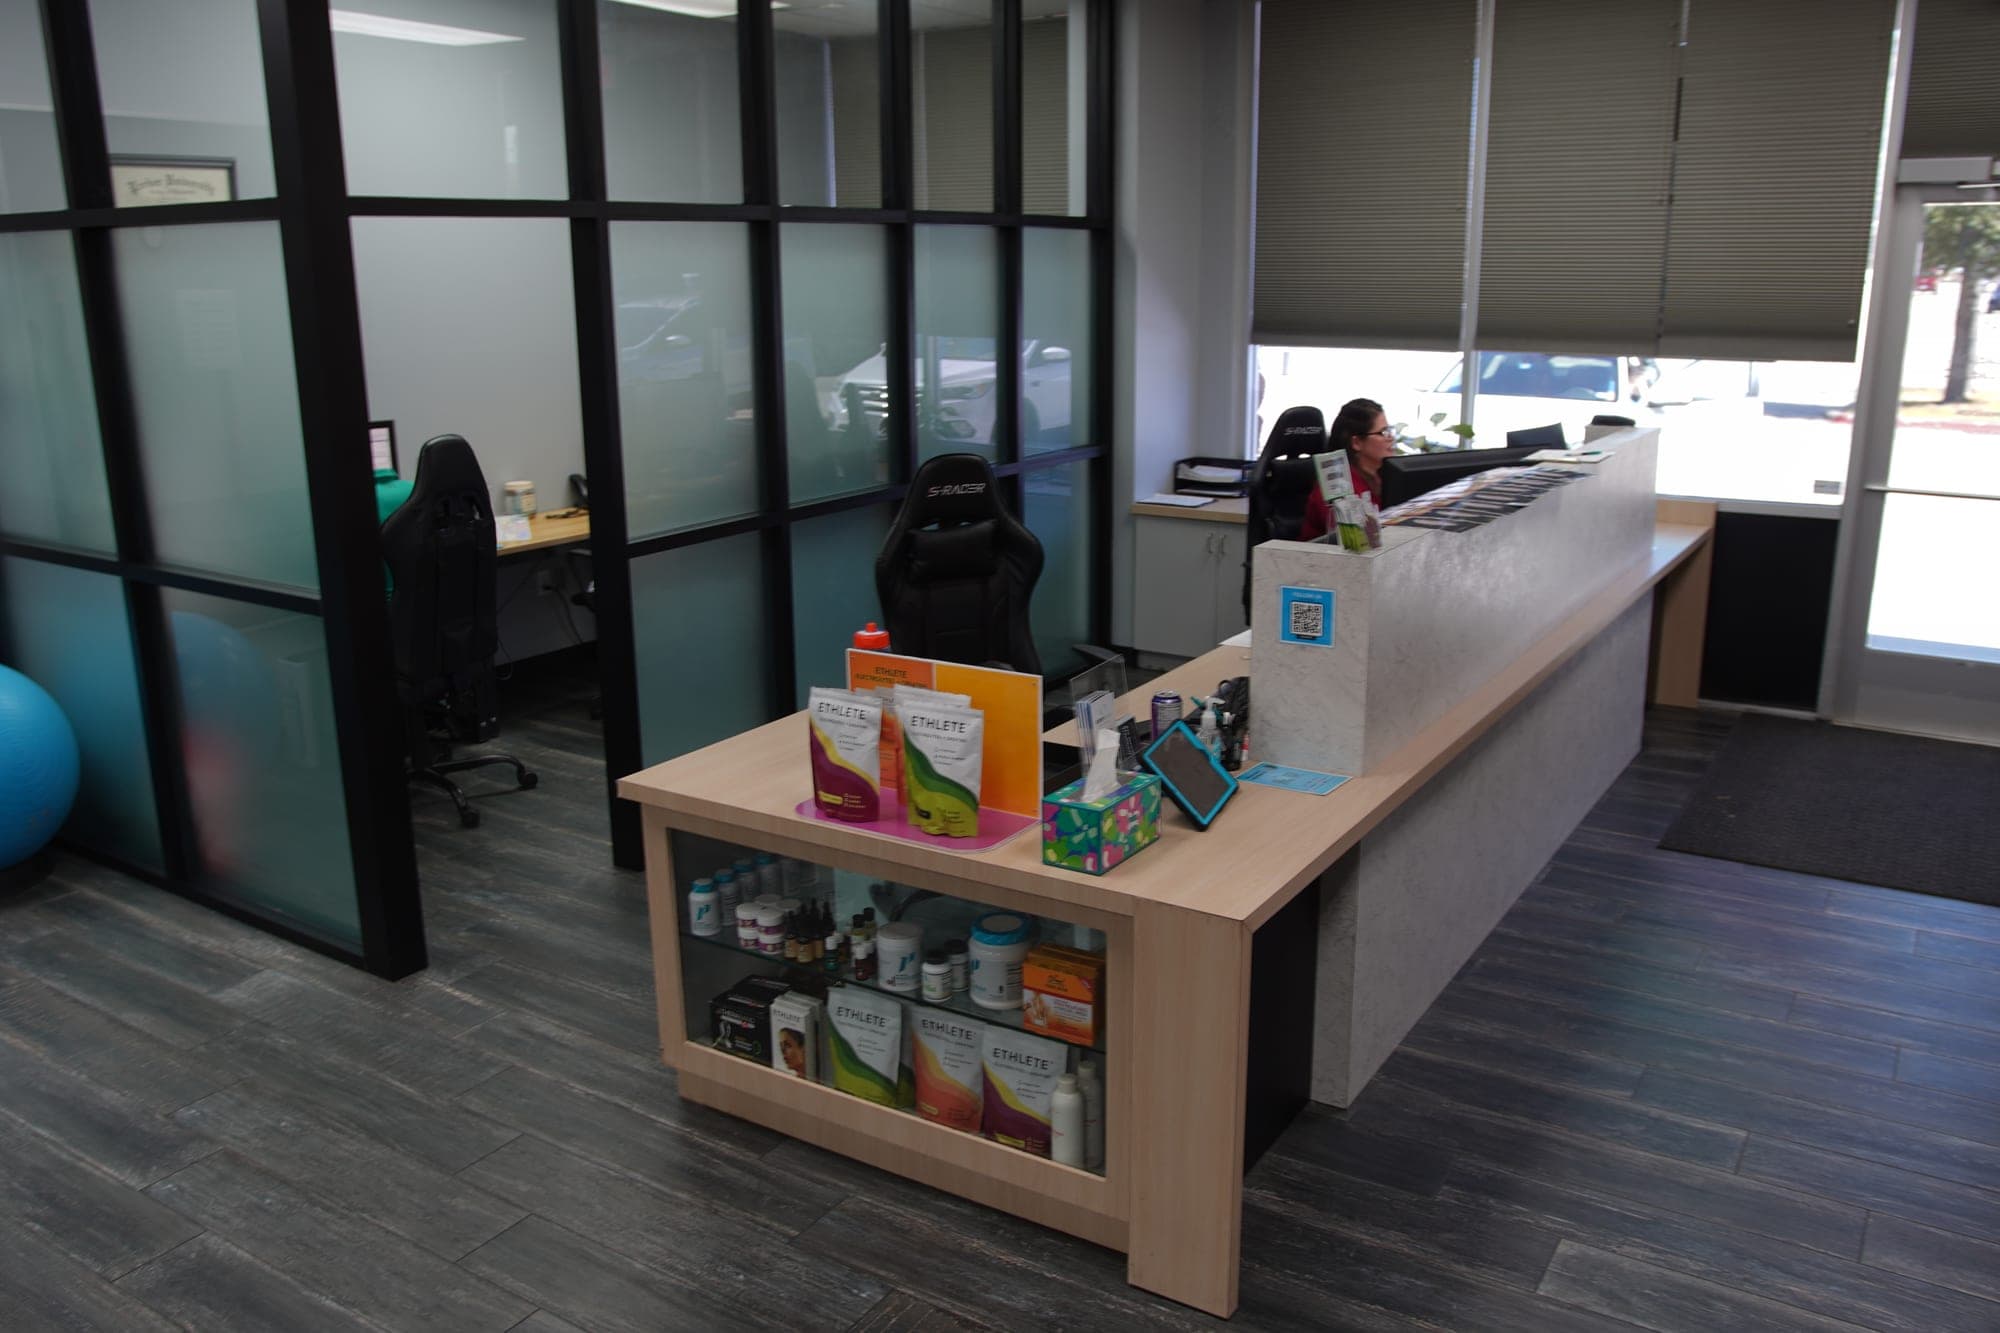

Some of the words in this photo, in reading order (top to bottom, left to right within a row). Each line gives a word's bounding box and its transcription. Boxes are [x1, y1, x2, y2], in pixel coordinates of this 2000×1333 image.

[927, 482, 986, 497] S-RACER
[818, 702, 866, 720] ETHLETE
[911, 715, 966, 734] ETHLETE
[836, 1006, 886, 1028] ETHLETE
[921, 1019, 972, 1040] ETHLETE
[993, 1047, 1049, 1070] ETHLETE
